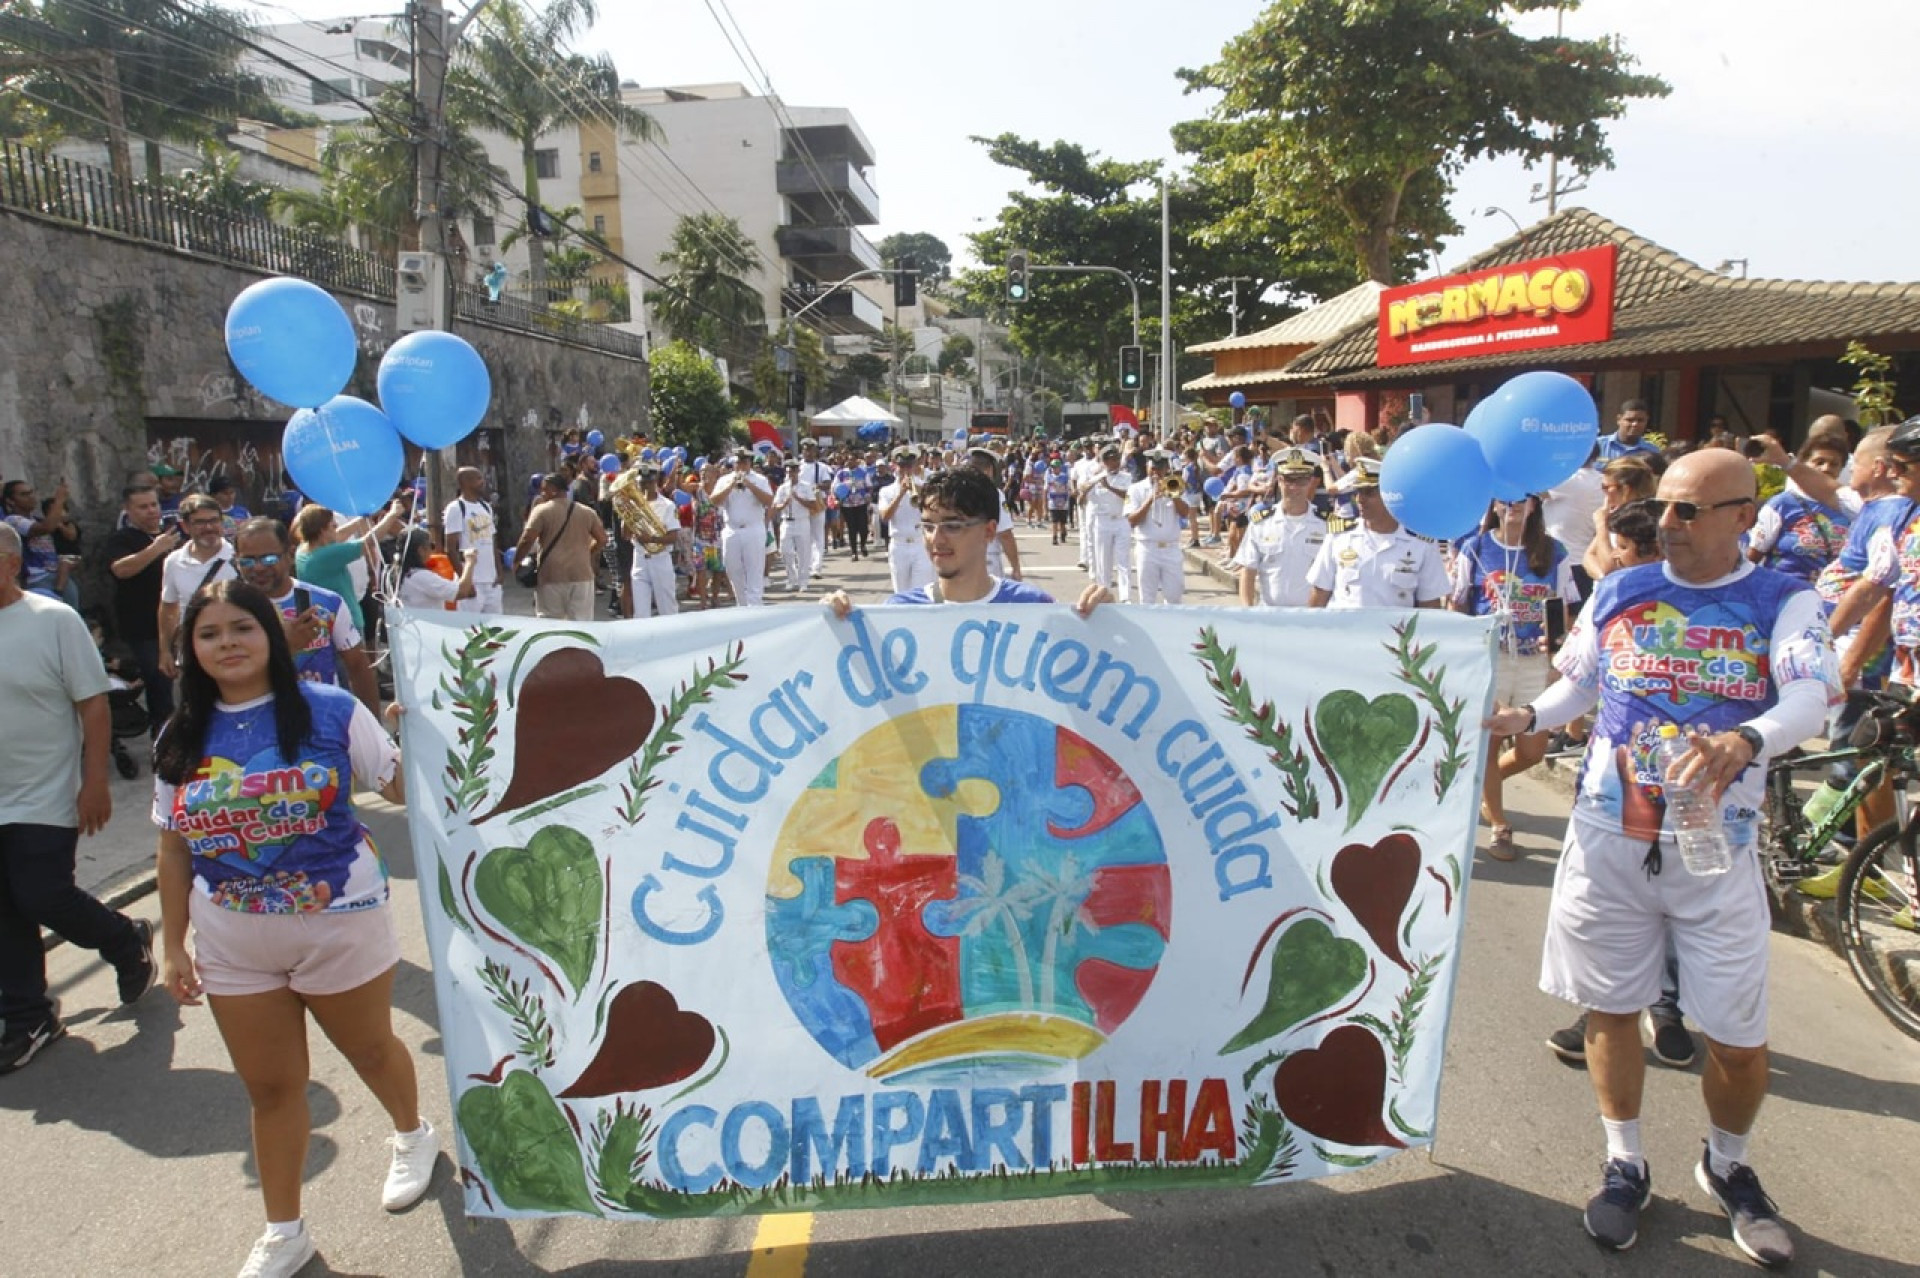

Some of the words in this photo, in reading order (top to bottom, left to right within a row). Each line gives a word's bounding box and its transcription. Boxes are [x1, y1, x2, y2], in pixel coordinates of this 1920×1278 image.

[1605, 618, 1768, 654] Autismo
[836, 608, 929, 709] de
[950, 618, 1162, 741] quem
[1611, 651, 1702, 675] Cuidar
[1707, 655, 1747, 676] de
[1676, 674, 1768, 701] Cuida!
[174, 806, 263, 833] Cuidar
[268, 800, 309, 819] de
[188, 834, 240, 855] uem
